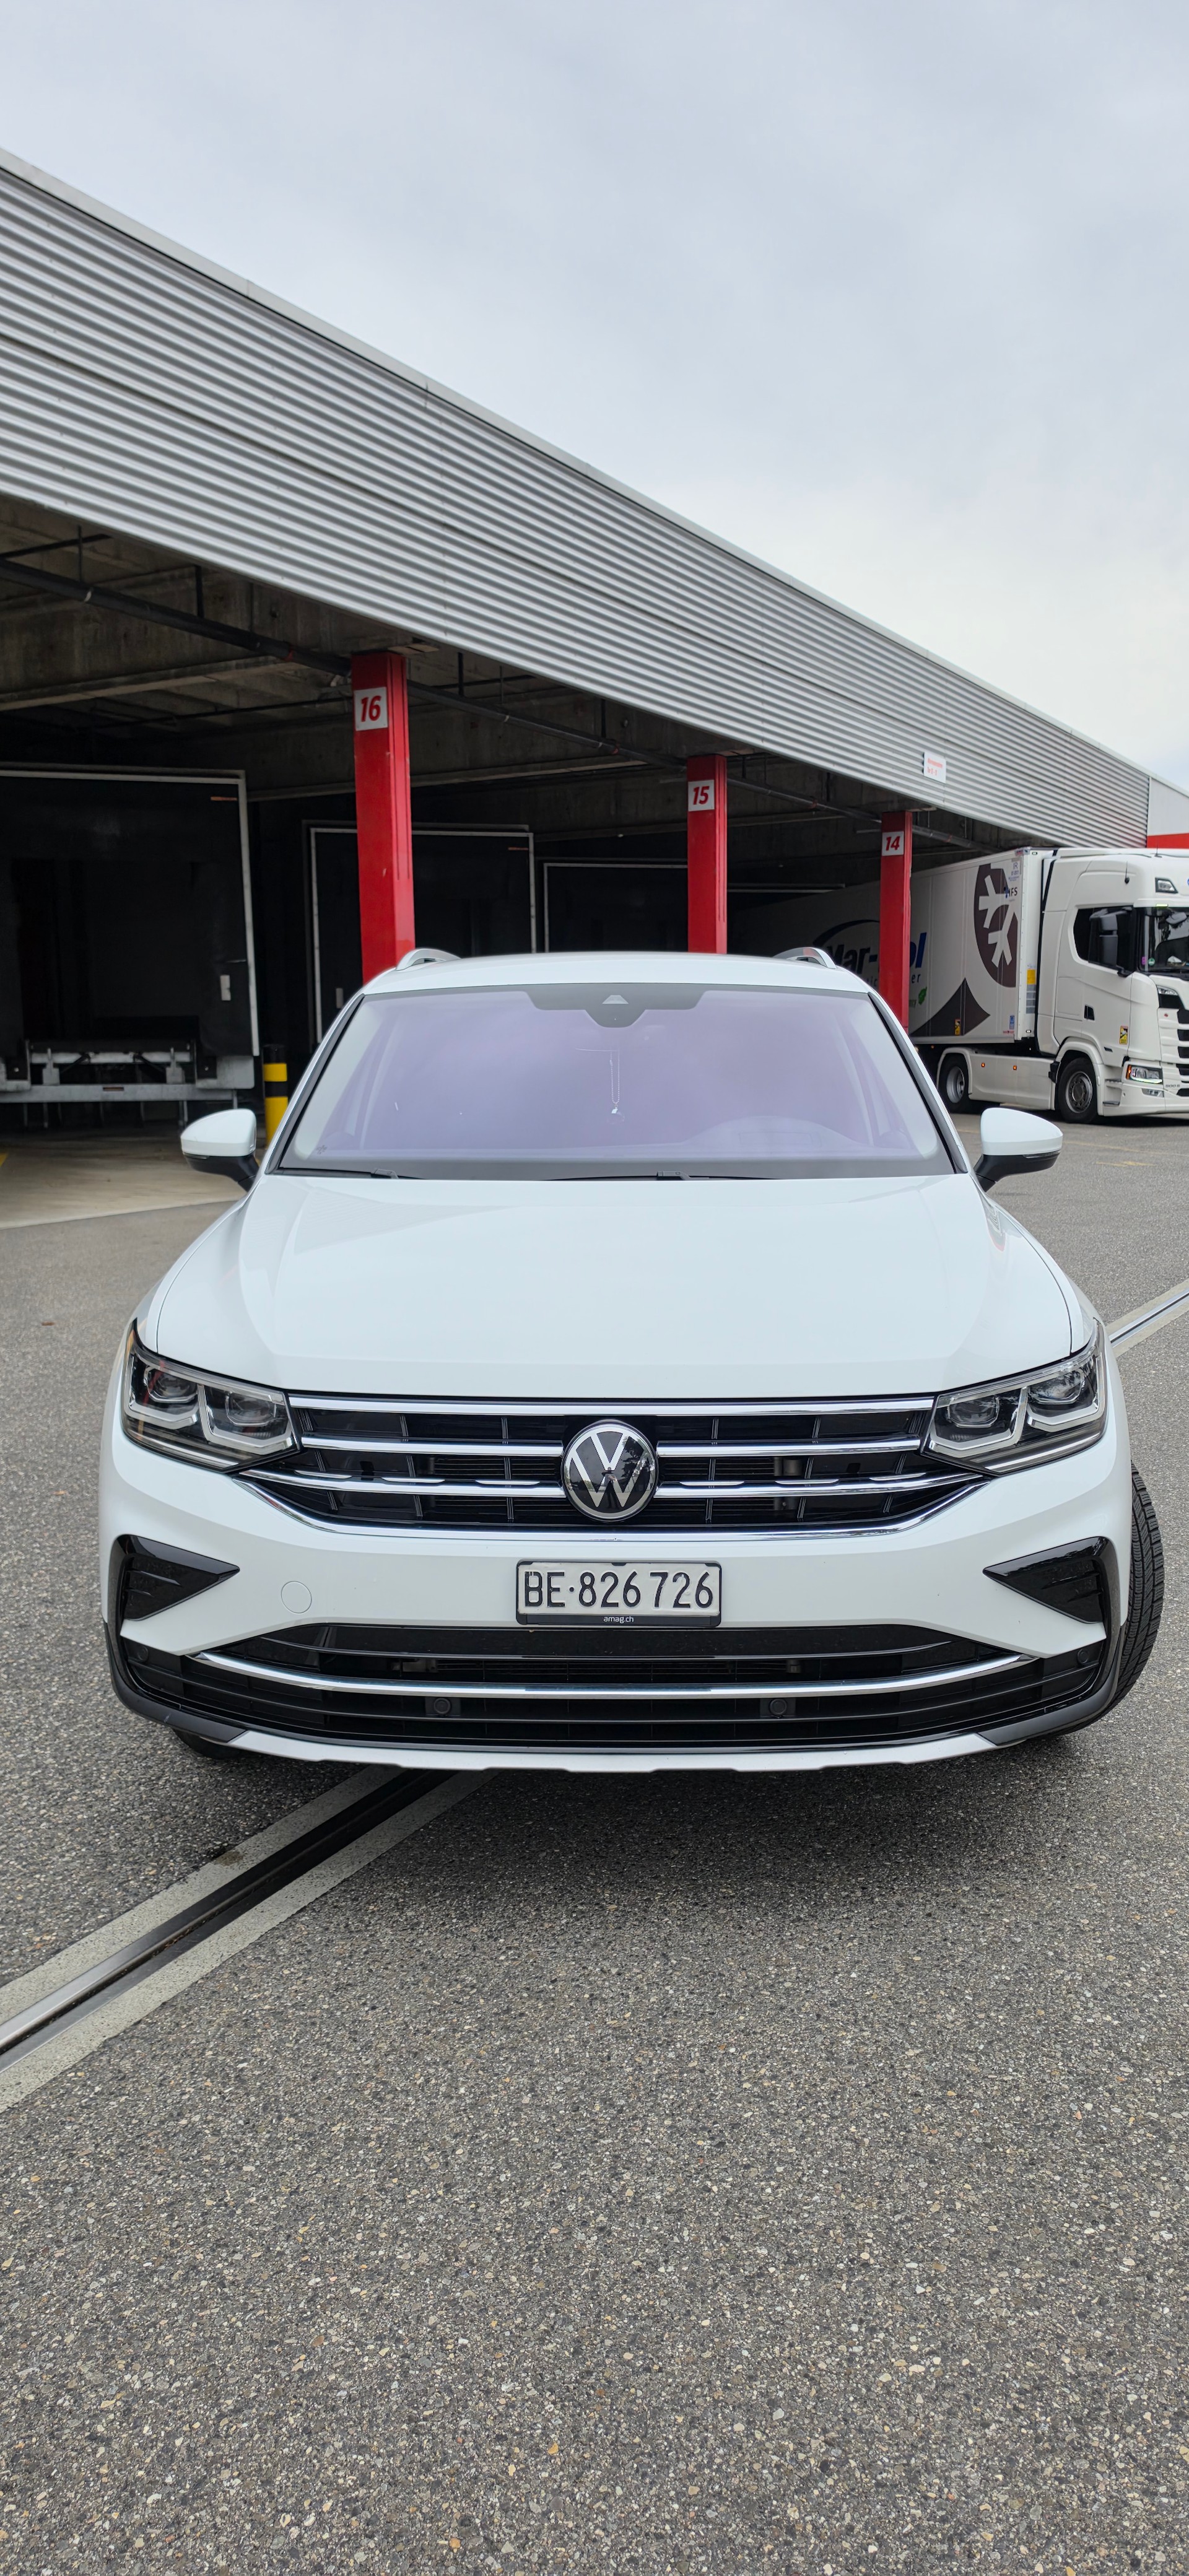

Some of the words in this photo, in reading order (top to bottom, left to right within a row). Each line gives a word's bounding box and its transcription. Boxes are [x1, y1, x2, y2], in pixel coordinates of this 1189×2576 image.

[361, 695, 381, 723] 16
[693, 786, 710, 805] 15
[886, 836, 900, 851] 14
[827, 933, 926, 973] Mar-l
[650, 1571, 713, 1608] 726
[603, 1616, 634, 1624] amag.ch
